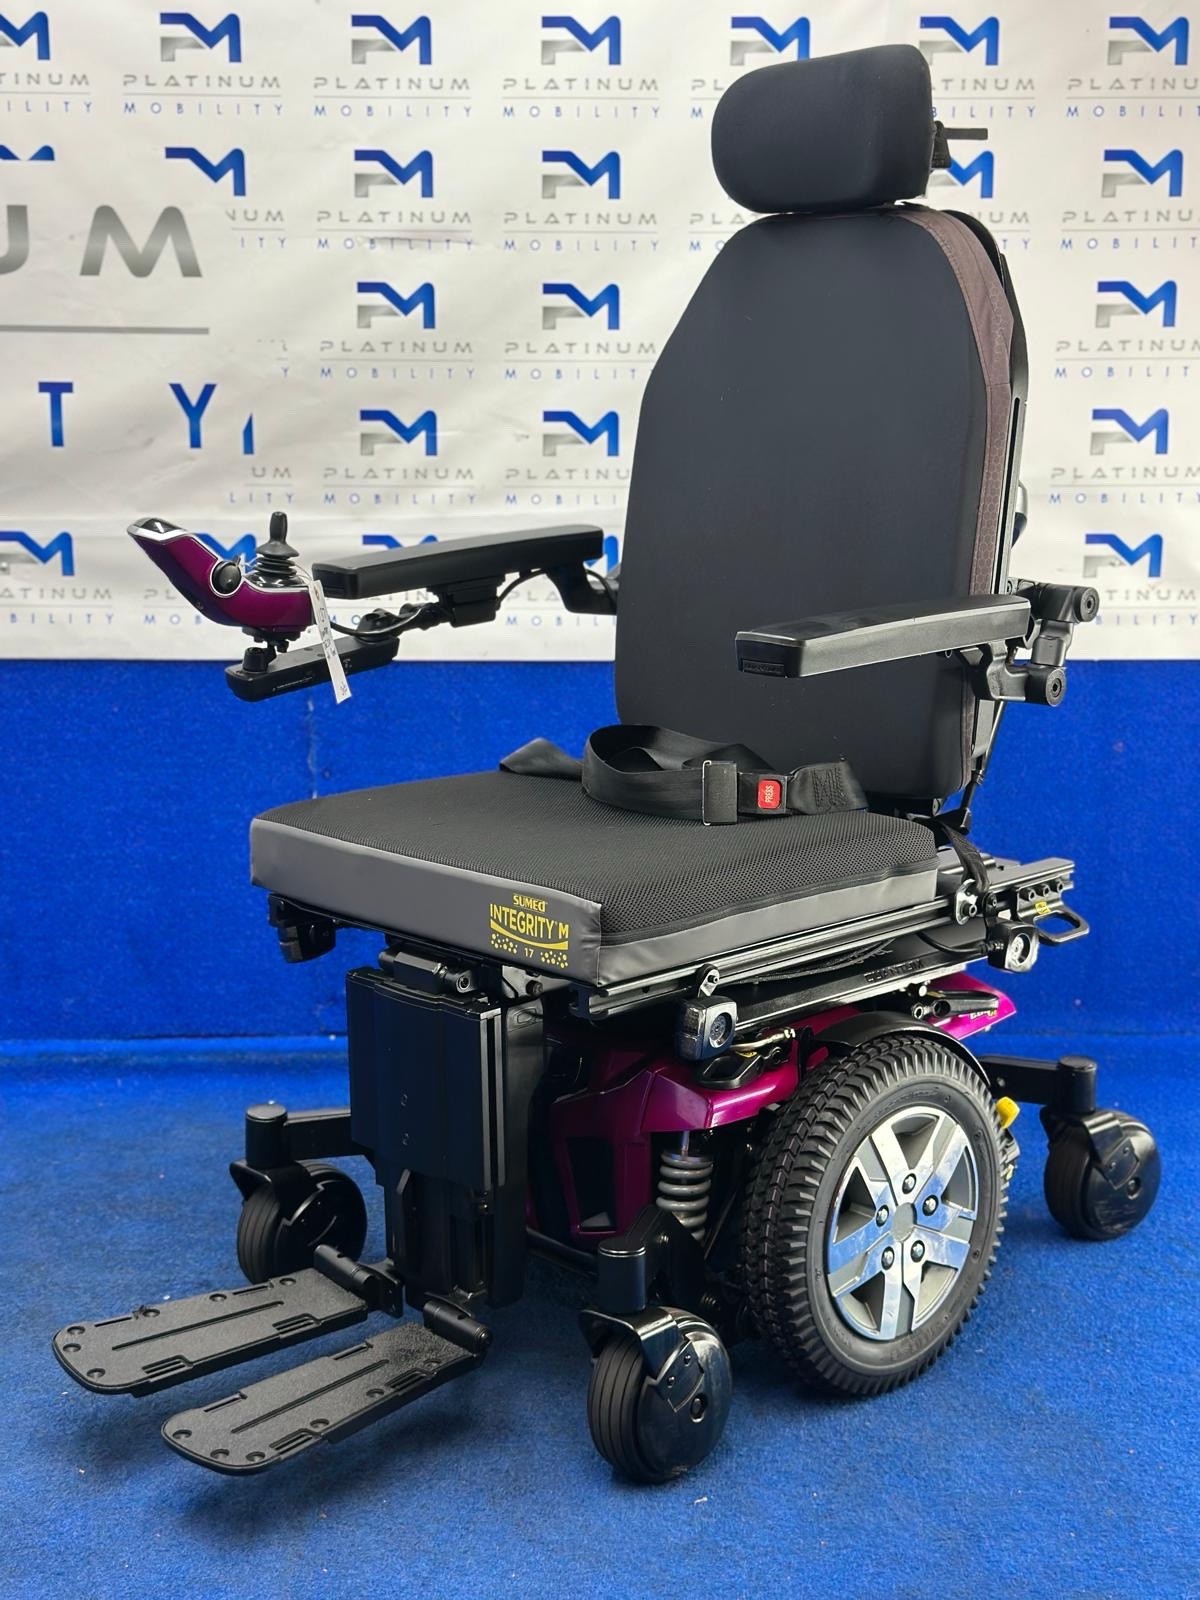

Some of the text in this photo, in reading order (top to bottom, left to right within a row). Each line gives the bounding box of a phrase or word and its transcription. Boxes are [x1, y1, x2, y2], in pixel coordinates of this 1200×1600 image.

[122, 74, 281, 89] PLATINUM
[313, 77, 471, 91] PLATINUM
[502, 78, 659, 91] PLATINUM
[932, 78, 1035, 91] TINUM
[123, 102, 283, 116] MOBILITY
[314, 105, 472, 117] MOBILITY
[502, 106, 660, 118] MOBILITY
[316, 210, 472, 224] PLATINUM
[504, 212, 657, 225] PLATINUM
[1062, 210, 1200, 224] PLATINU
[317, 237, 475, 250] MOBILITY
[504, 240, 659, 252] MOBILITY
[320, 341, 473, 353] PLATINUM
[505, 342, 657, 355] PLATINUM
[320, 367, 475, 379] MOBILITY
[504, 368, 653, 381] MOBILIT
[323, 467, 474, 480] PLATINUM
[324, 493, 477, 505] MOBILITY
[489, 903, 569, 940] INTEGRITY M
[524, 946, 535, 959] 17
